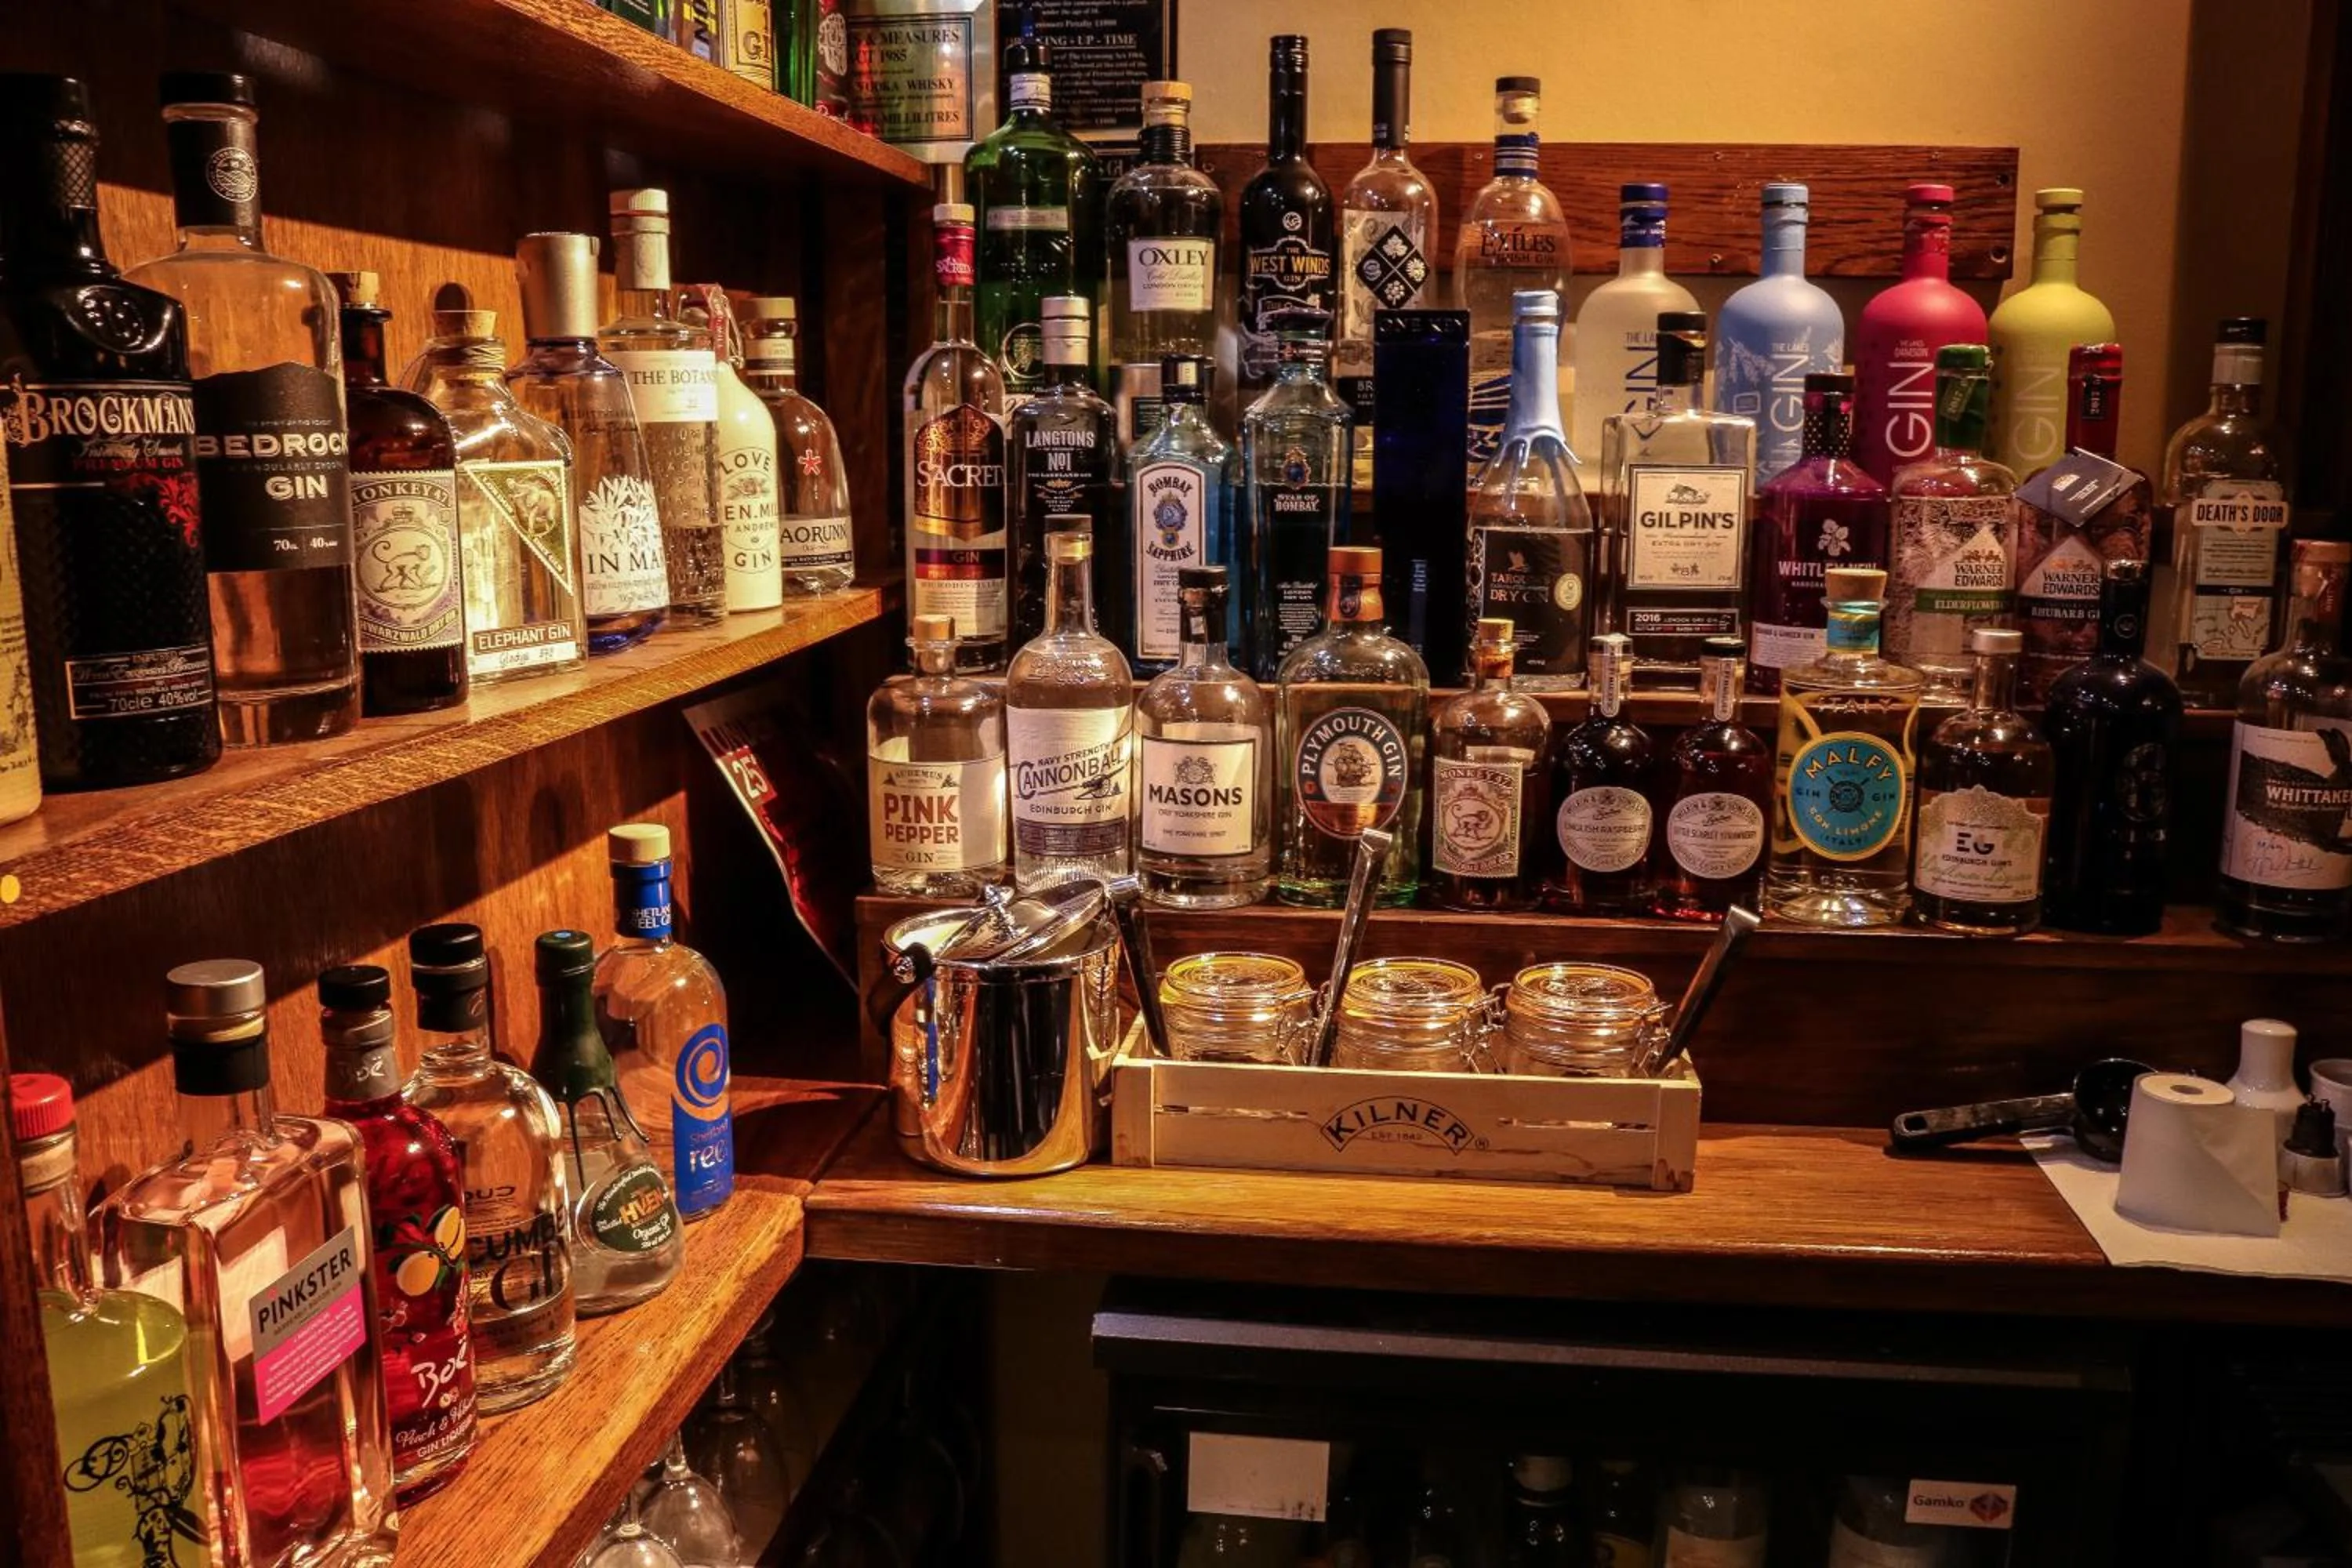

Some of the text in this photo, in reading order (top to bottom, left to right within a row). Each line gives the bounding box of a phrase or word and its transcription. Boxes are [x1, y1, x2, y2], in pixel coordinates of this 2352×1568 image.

[883, 28, 960, 45] MEASURES
[1104, 34, 1137, 45] TIME
[880, 49, 908, 64] 1985
[907, 78, 954, 91] WHISKY
[881, 111, 960, 125] MILLILITRES
[1138, 247, 1208, 266] OXLEY
[1250, 256, 1330, 274] WEST WINDS
[1625, 332, 1640, 343] THE
[632, 370, 666, 385] THE
[1769, 354, 1809, 432] GIN
[1885, 361, 1935, 458] GIN
[2013, 366, 2062, 461] GIN
[9, 391, 195, 448] BROCKMANS
[191, 433, 349, 459] BEDROCK
[1025, 430, 1095, 448] LANGTONS
[719, 452, 771, 475] LOVE
[265, 474, 328, 501] GIN
[1147, 476, 1194, 498] BOMBAY
[1274, 499, 1319, 512] BOMBAY
[2196, 503, 2284, 523] DEATH'S DOOR
[1640, 510, 1735, 529] GILPIN'S
[780, 521, 848, 543] AORUNN
[734, 550, 772, 568] GIN
[952, 551, 981, 564] GIN
[1145, 540, 1196, 562] SAPPHIRE
[1954, 564, 2005, 575] WARNER
[2042, 571, 2100, 584] WARNER
[1955, 575, 2004, 587] EDWARDS
[2042, 583, 2100, 596] EDWARDS
[1490, 589, 1519, 603] DRY
[1635, 613, 1661, 622] 2016
[2031, 606, 2085, 619] RHUBARB
[478, 624, 572, 650] ELEPHANT GIN
[1301, 715, 1403, 777] PLYMOUTH GIN
[1037, 756, 1061, 767] NAVY
[1806, 746, 1894, 781] MALFY
[1017, 746, 1125, 800] CANNONBALL
[1149, 782, 1243, 807] MASONS
[2265, 785, 2352, 804] WHITTAKE
[884, 792, 960, 824] PINK
[1029, 804, 1112, 815] EDINBURGH GIN
[884, 822, 959, 844] PEPPER
[1956, 831, 1995, 855] EG
[905, 851, 935, 863] GIN
[1327, 1101, 1468, 1146] KILNER
[258, 1247, 352, 1334] PINKSTER
[416, 1442, 438, 1458] GIN
[1913, 1494, 1965, 1508] Gamko
